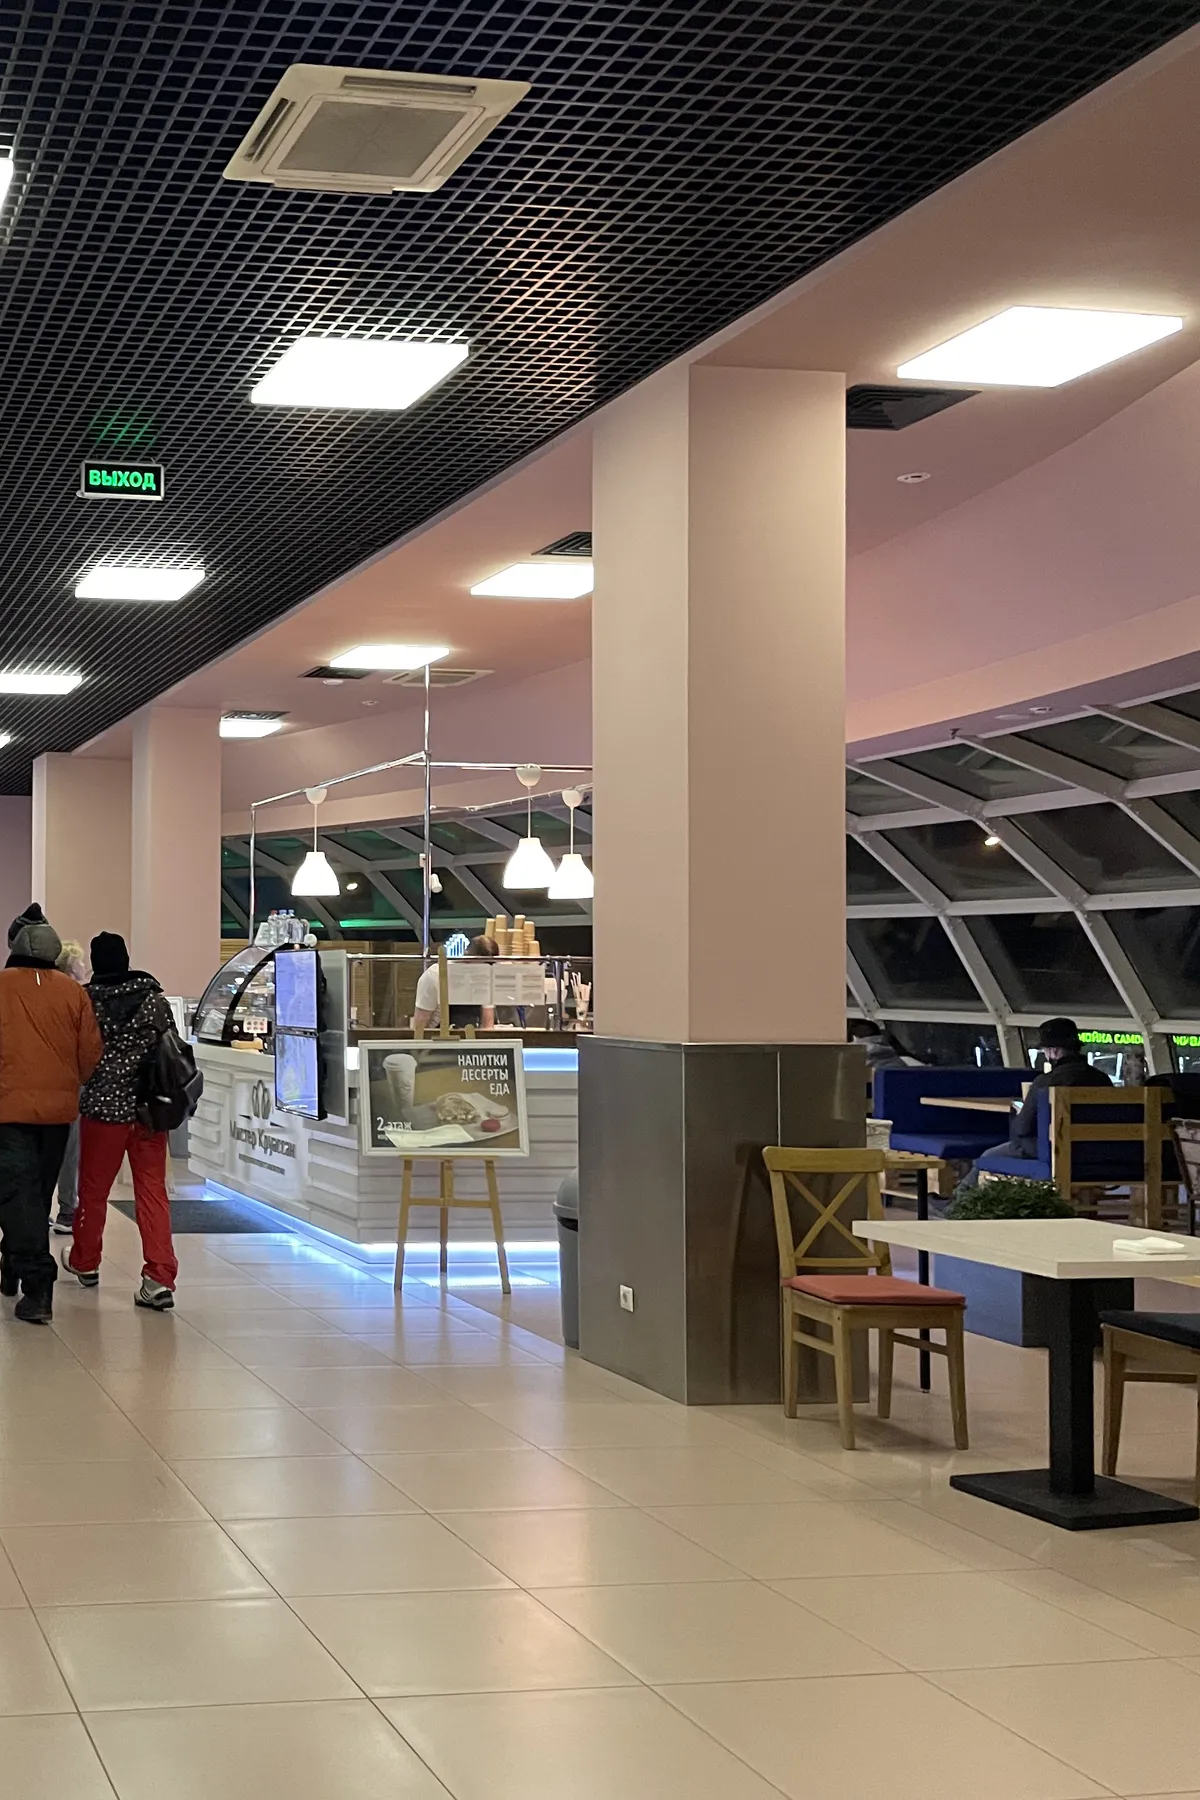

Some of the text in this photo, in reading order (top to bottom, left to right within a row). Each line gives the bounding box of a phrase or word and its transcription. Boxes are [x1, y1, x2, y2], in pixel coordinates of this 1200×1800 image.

[89, 469, 156, 491] ВЫХОД
[457, 1054, 508, 1067] НАПИТКИ
[461, 1068, 509, 1082] ДЕСЕРТЫ
[489, 1082, 510, 1096] ЕДА
[376, 1116, 386, 1131] 2
